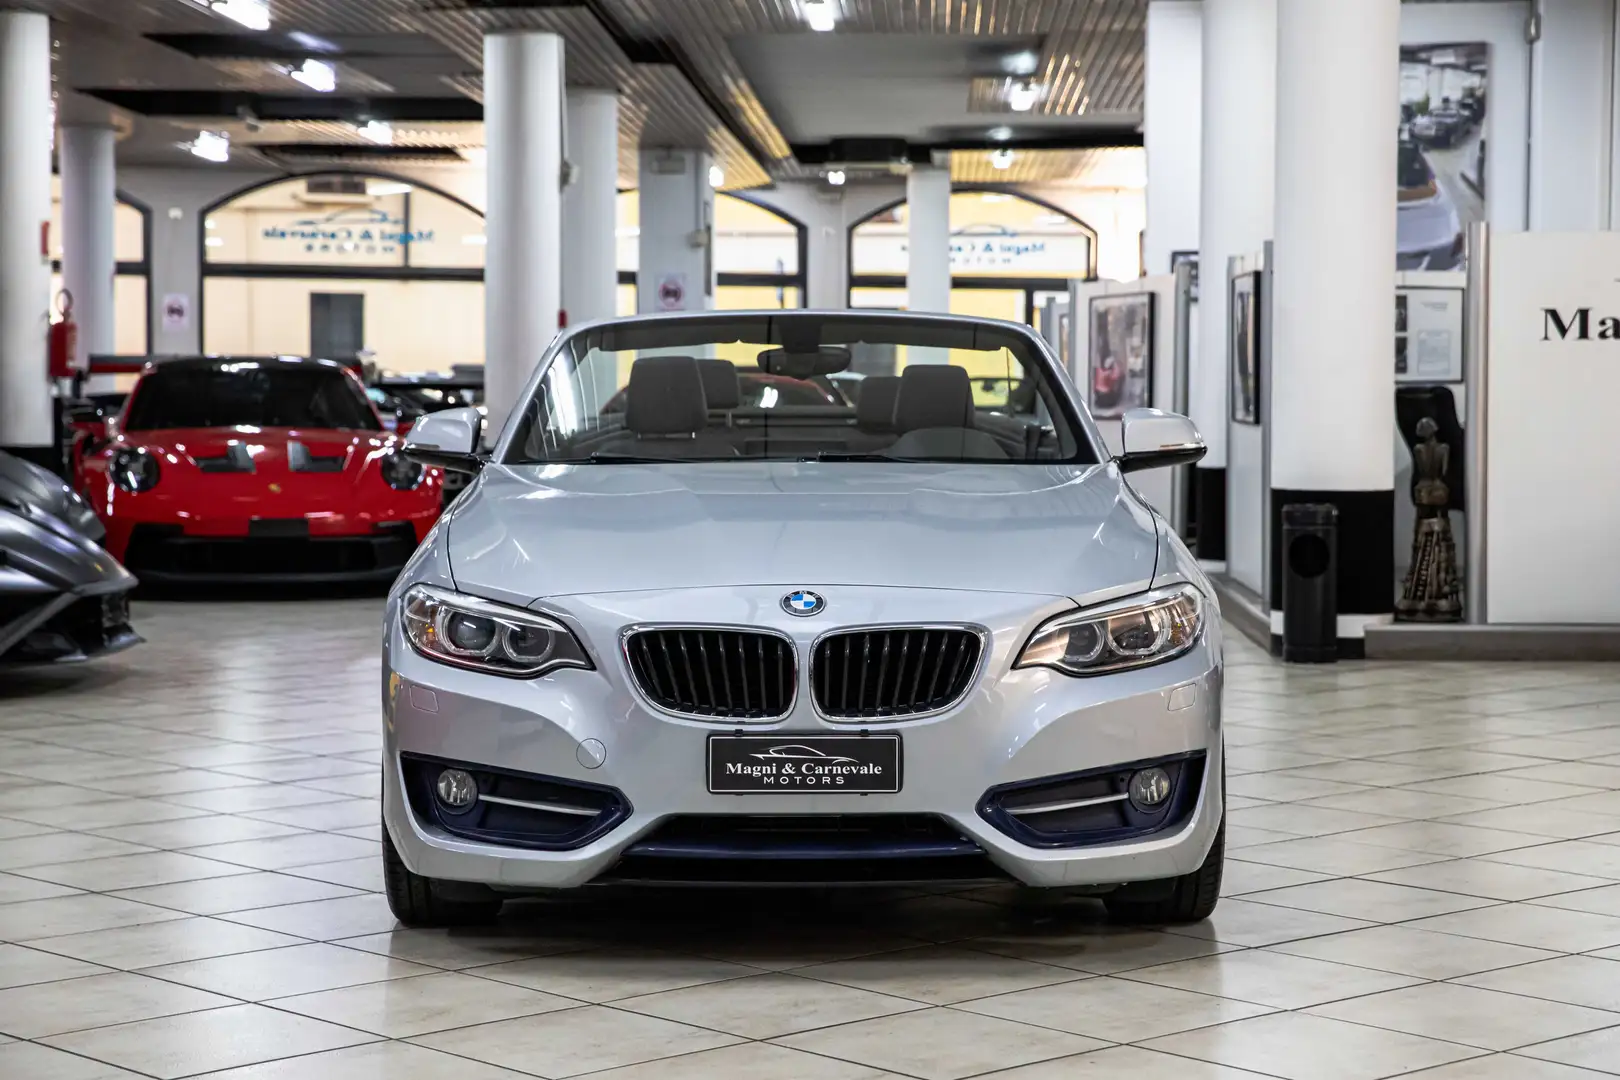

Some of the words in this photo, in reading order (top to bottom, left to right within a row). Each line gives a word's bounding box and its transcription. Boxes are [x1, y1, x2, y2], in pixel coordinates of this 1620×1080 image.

[725, 763, 777, 777] Magni
[781, 762, 797, 775] &
[801, 762, 883, 775] Carnevale
[763, 776, 845, 785] MOTORS
